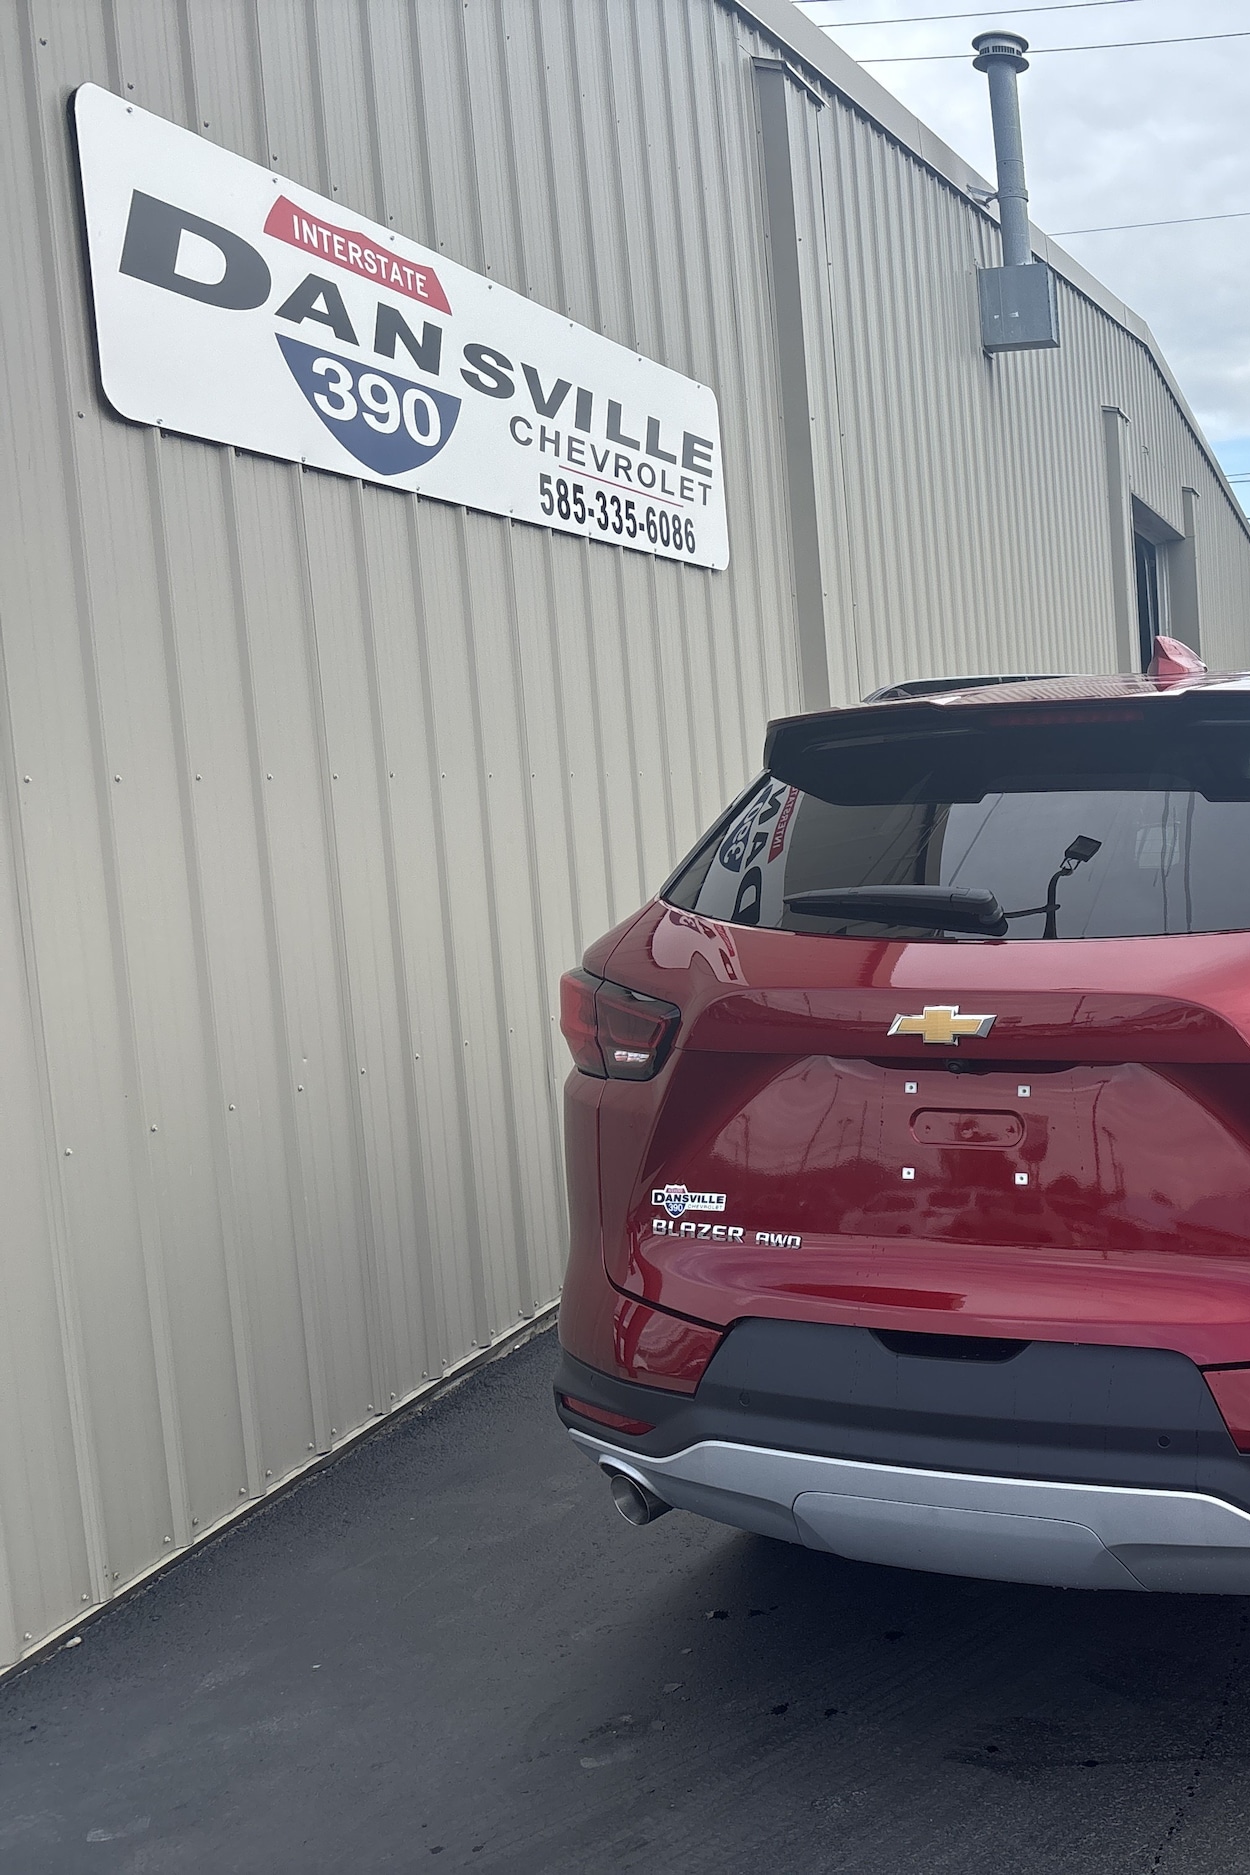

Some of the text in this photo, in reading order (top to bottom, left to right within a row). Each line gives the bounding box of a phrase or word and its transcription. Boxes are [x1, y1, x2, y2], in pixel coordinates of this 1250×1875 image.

[292, 214, 429, 298] INTERSTATE
[119, 189, 714, 478] DANSVILLE
[311, 356, 442, 448] 390
[509, 415, 712, 506] CHEVROLET
[539, 472, 696, 554] 585-335-6086
[652, 1218, 802, 1249] BLAZER AWD
[654, 1192, 725, 1204] DANSVILLE
[668, 1203, 683, 1212] 390
